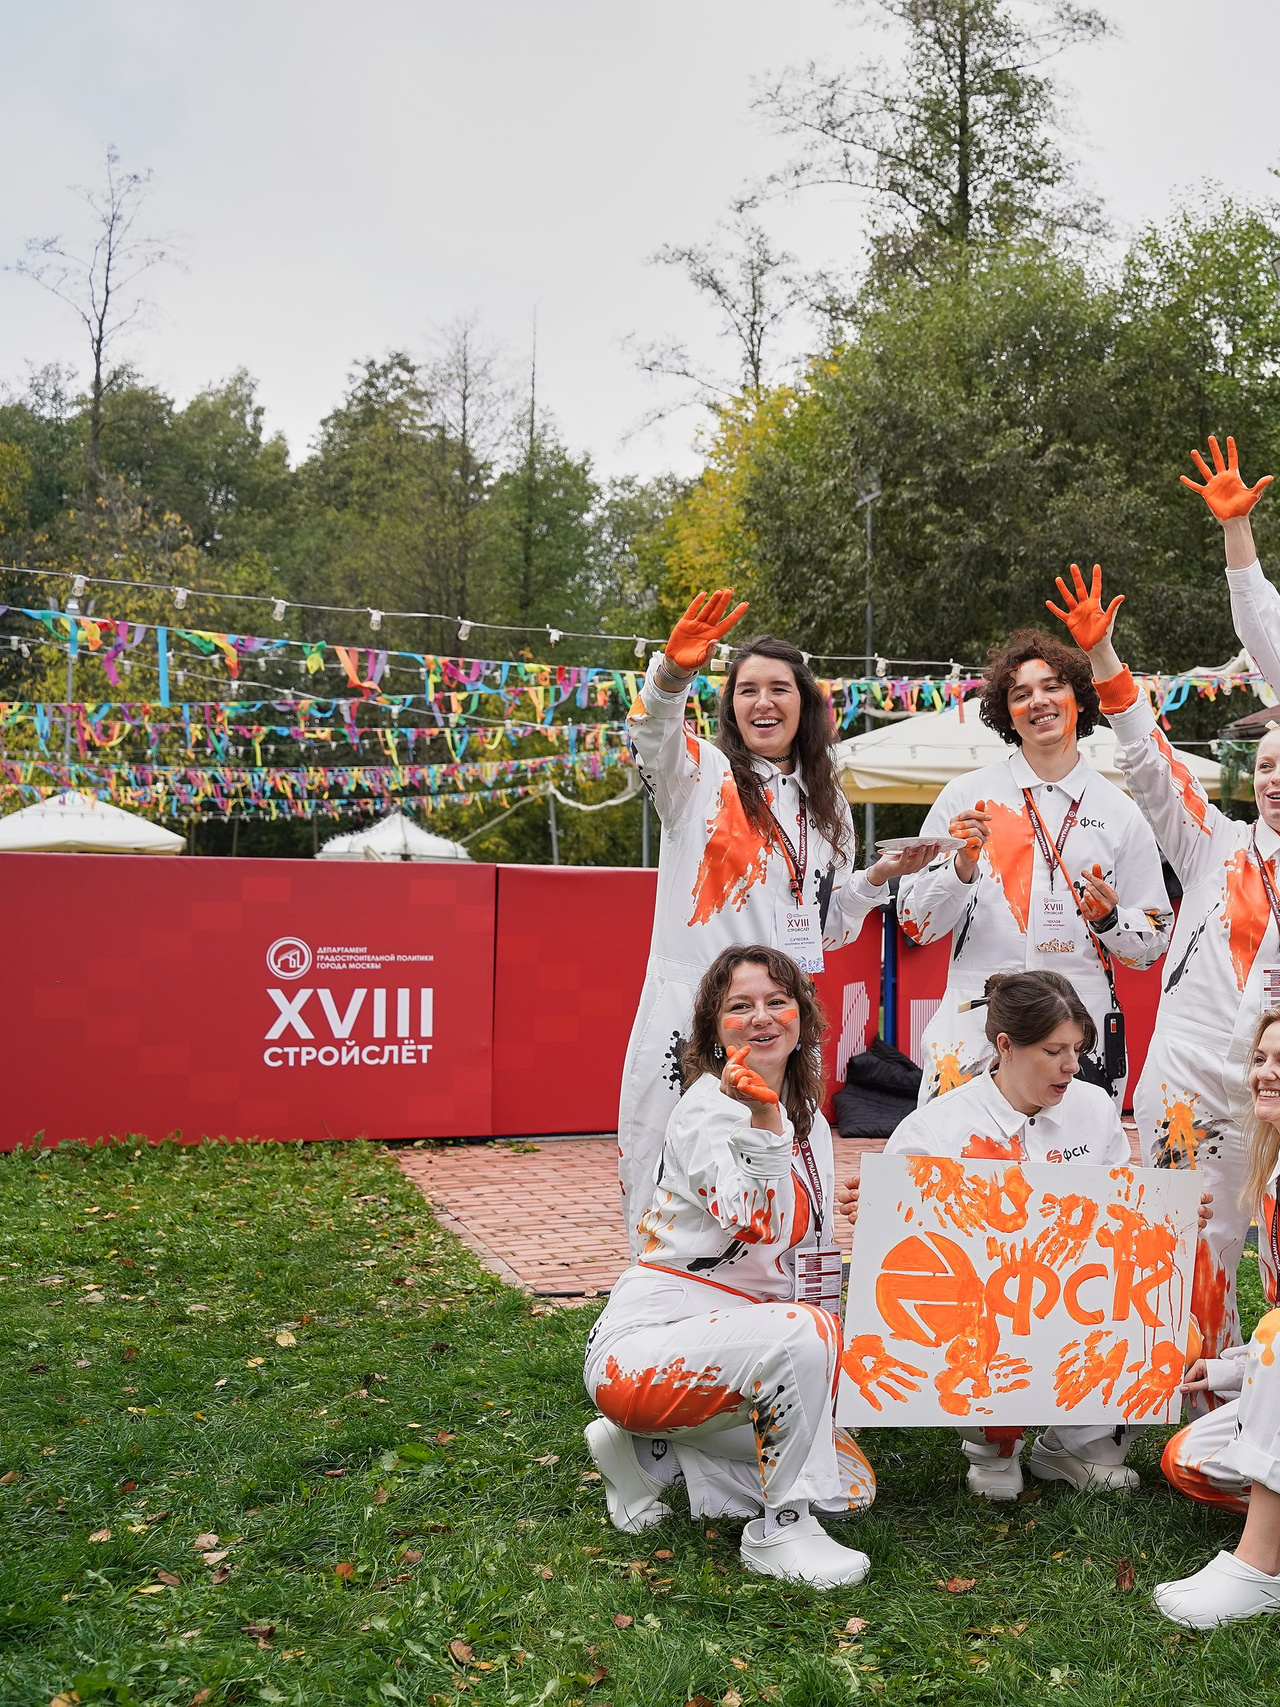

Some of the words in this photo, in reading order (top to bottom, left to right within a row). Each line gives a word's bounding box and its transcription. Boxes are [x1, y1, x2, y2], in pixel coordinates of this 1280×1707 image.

[1080, 817, 1105, 829] ФСК
[787, 918, 809, 928] XVIII
[264, 988, 434, 1040] XVIII
[263, 1039, 433, 1067] СТРОЙСЛЁТ
[1063, 1144, 1090, 1161] ФСК
[806, 1156, 821, 1191] ФУНДАМЕНТ
[985, 1250, 1172, 1335] ФСК
